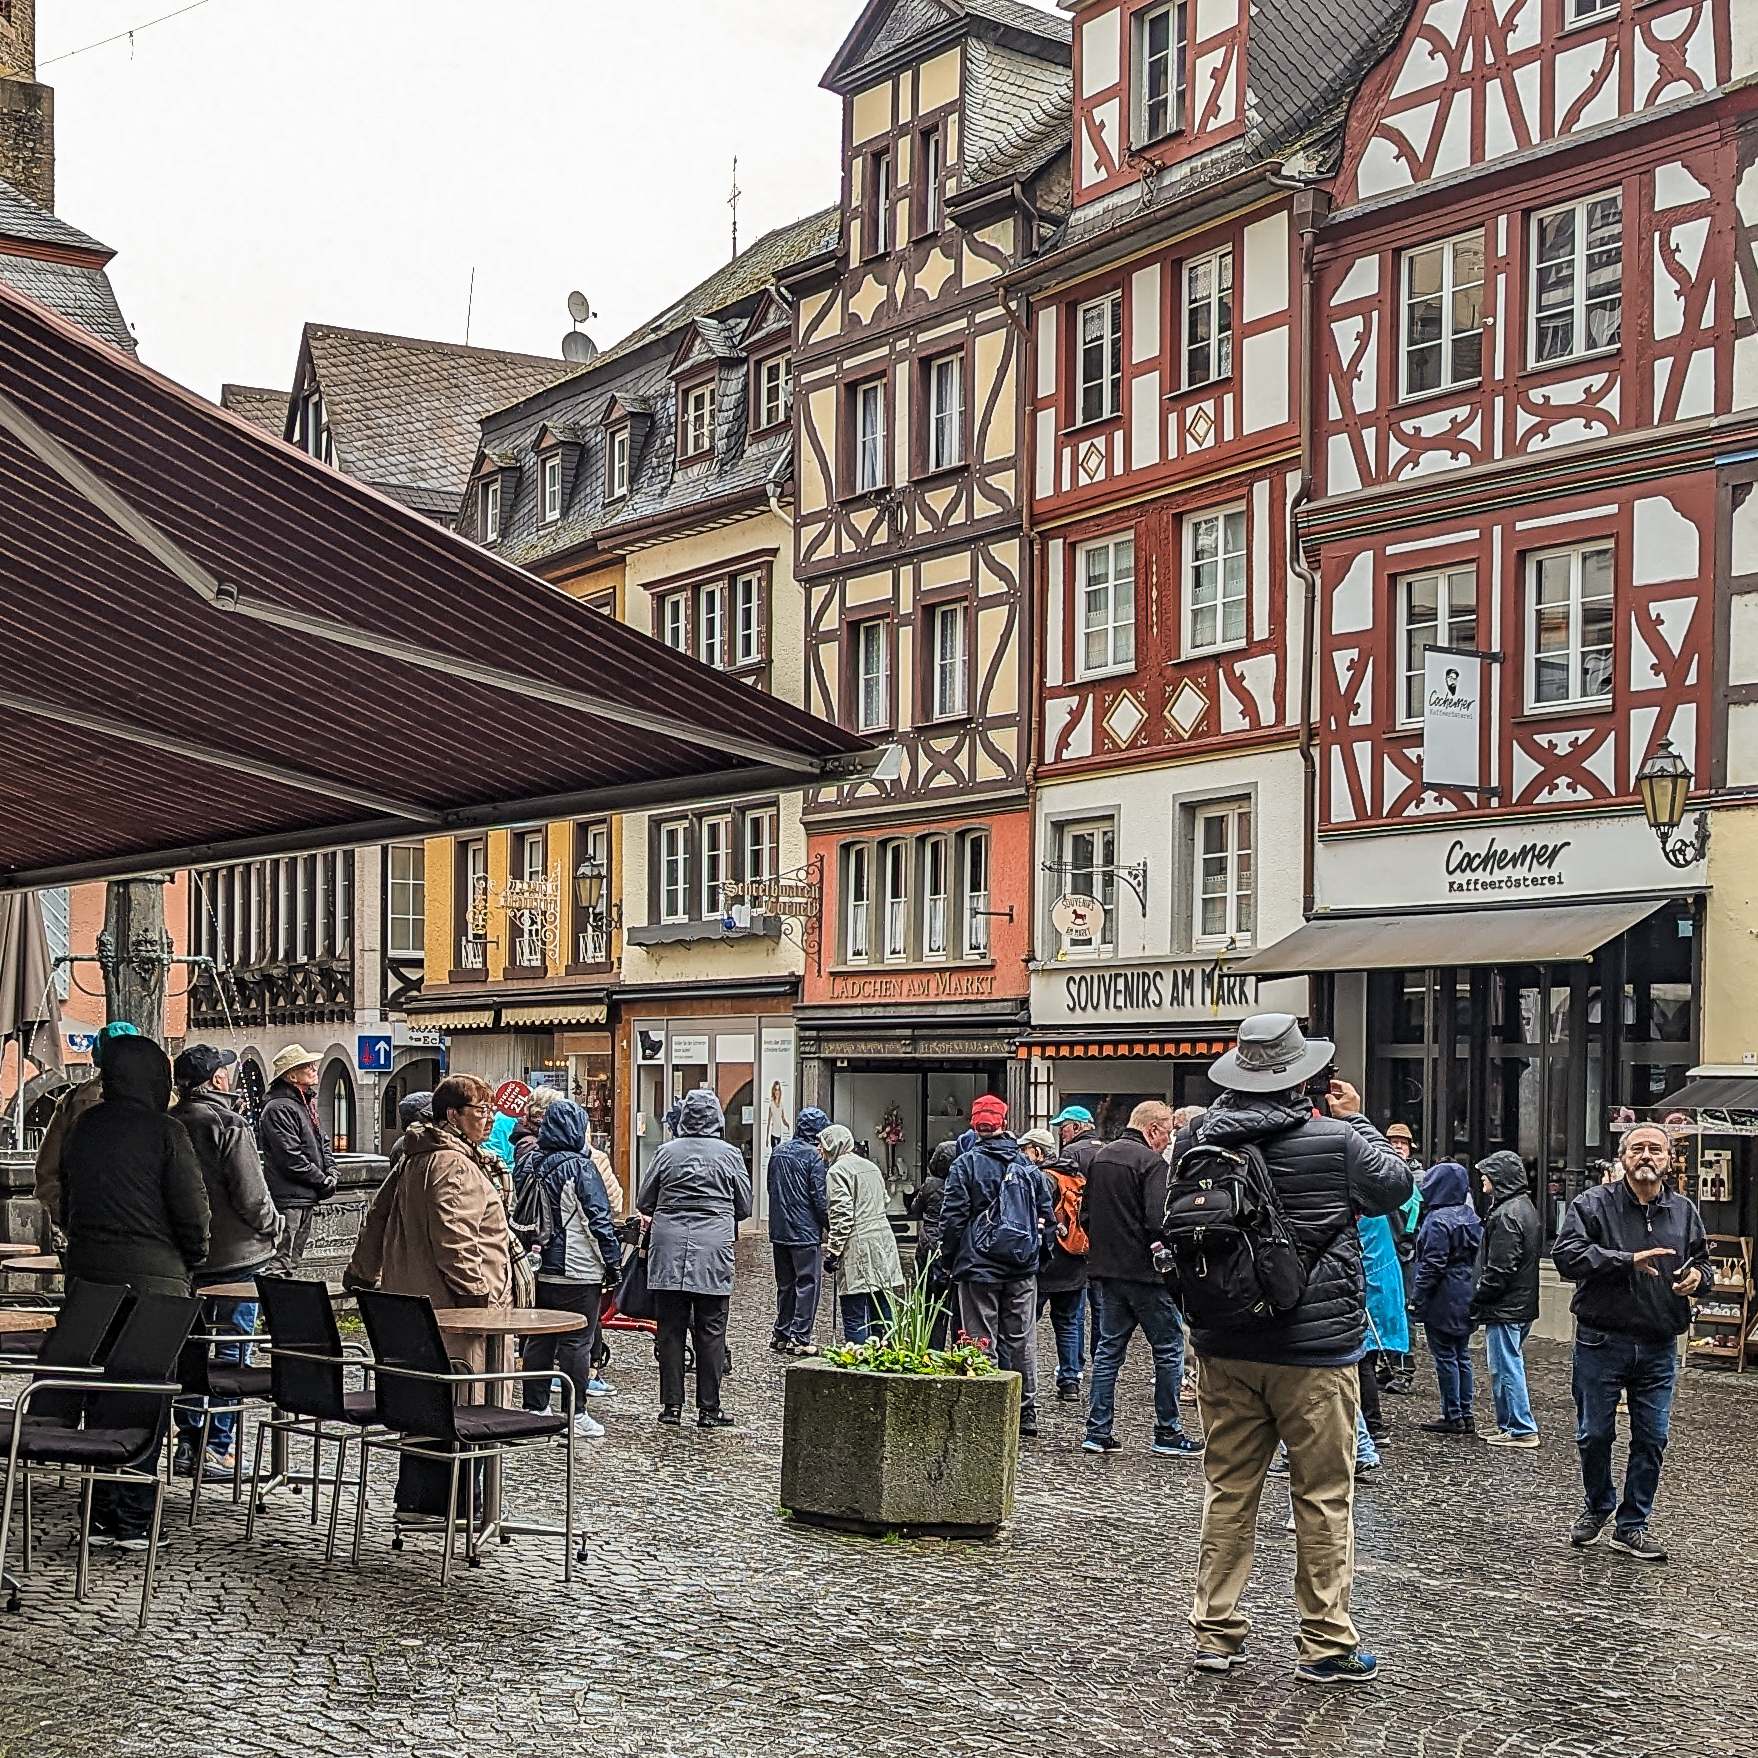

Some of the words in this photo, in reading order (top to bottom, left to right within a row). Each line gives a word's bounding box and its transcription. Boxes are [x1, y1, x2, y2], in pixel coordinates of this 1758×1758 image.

[1428, 689, 1476, 711] Cochemer
[1445, 837, 1572, 876] Cochemer
[724, 880, 820, 897] Schreibwaren
[1448, 871, 1565, 893] Kaffeerösterei
[934, 971, 997, 996] MARKT
[1065, 970, 1165, 1012] SOUVENIRS
[1169, 968, 1195, 1007] AM
